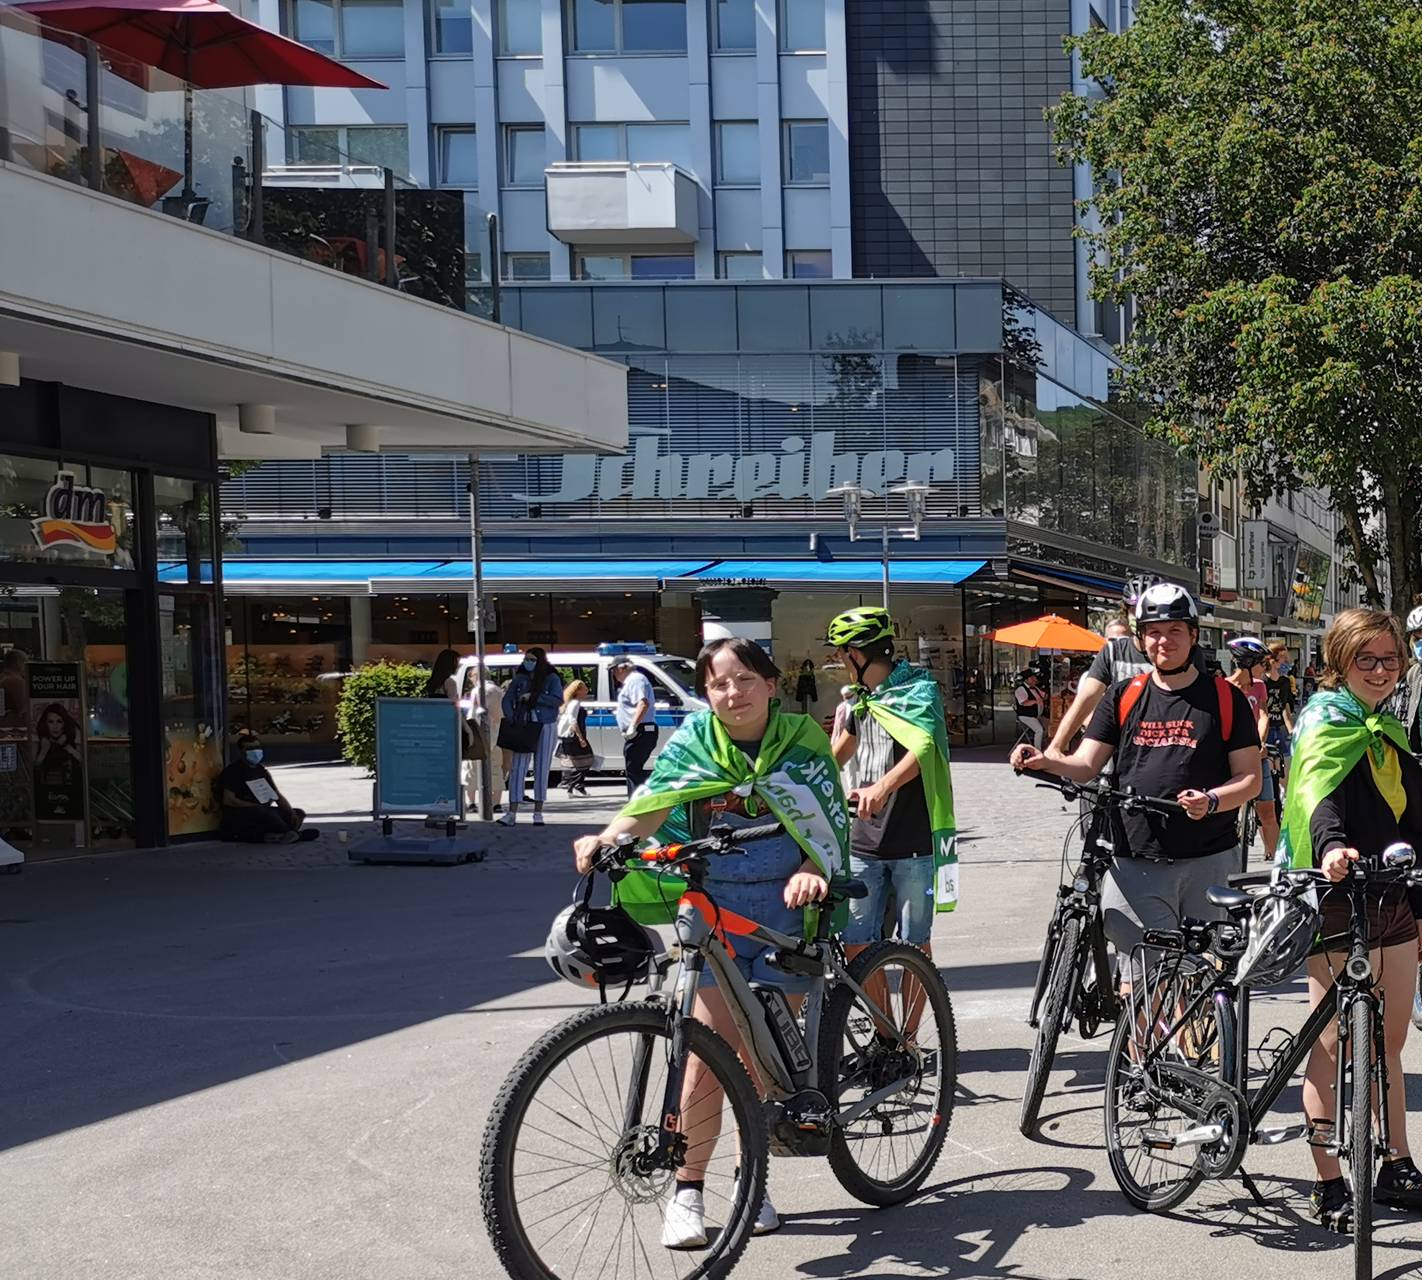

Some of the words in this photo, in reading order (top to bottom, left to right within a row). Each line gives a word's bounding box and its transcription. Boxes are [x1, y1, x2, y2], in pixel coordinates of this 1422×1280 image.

[511, 427, 954, 501] Schreiber
[50, 474, 105, 523] dm
[32, 682, 56, 690] YOUR
[56, 682, 77, 690] HAIR
[1139, 729, 1167, 737] DICK
